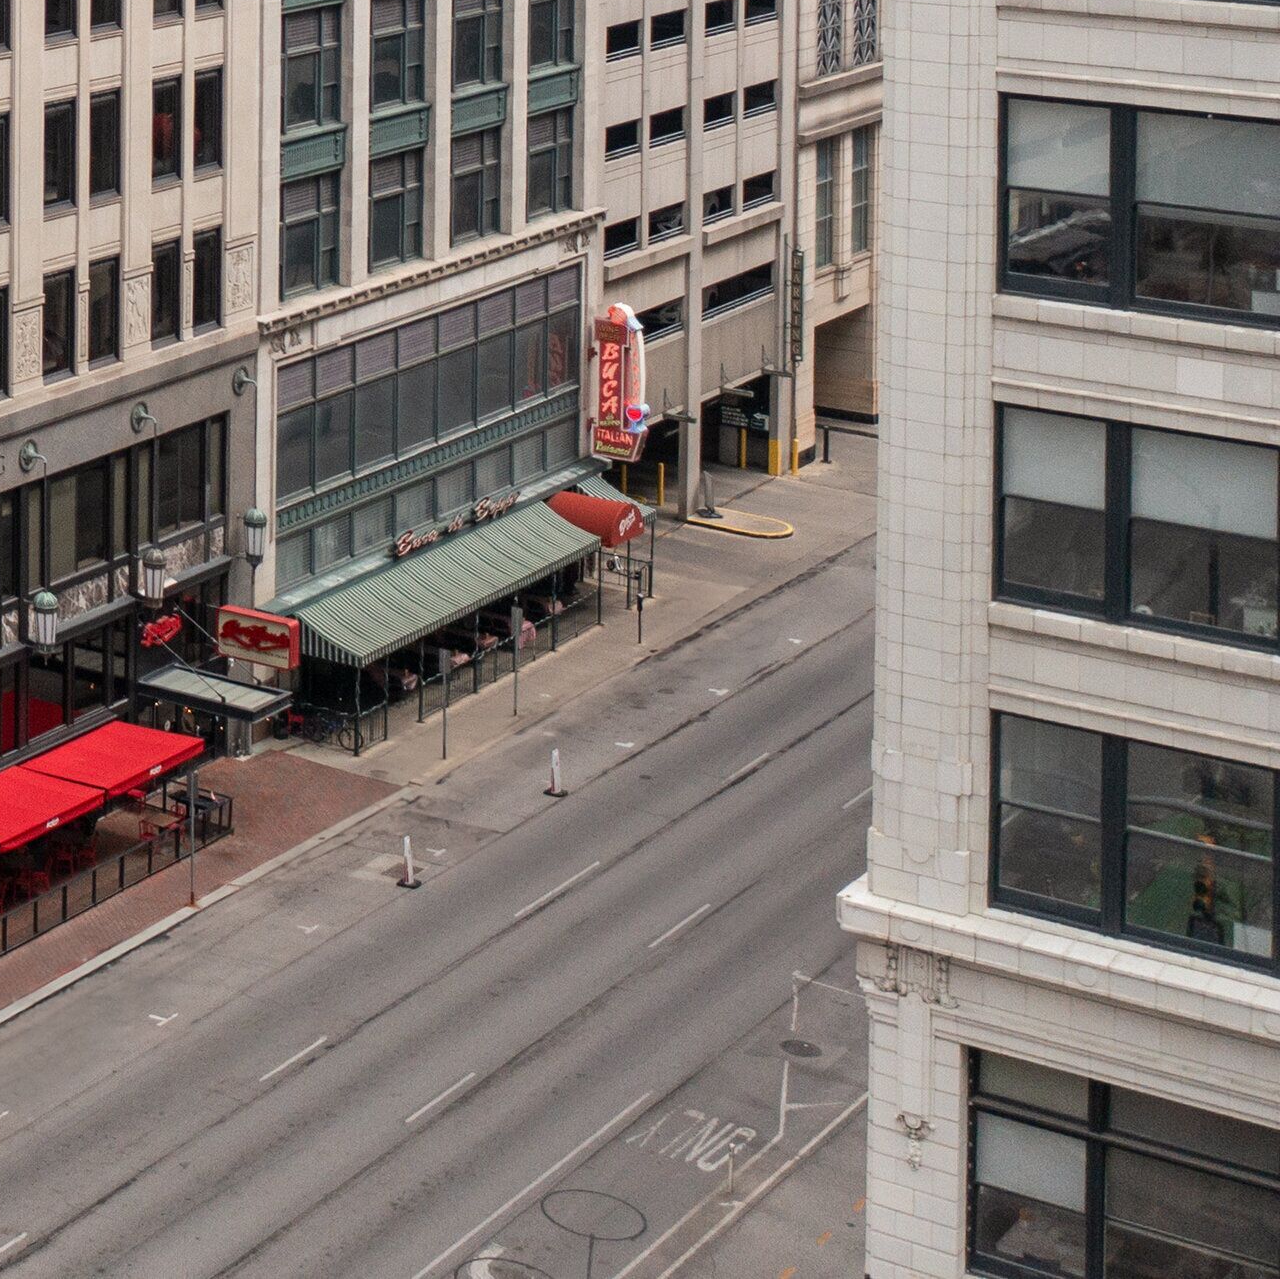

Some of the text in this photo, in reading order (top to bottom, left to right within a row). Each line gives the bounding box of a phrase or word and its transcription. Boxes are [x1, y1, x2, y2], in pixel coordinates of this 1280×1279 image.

[792, 257, 801, 355] PARKING
[601, 342, 620, 414] BUCA
[596, 428, 633, 446] ITALIAN
